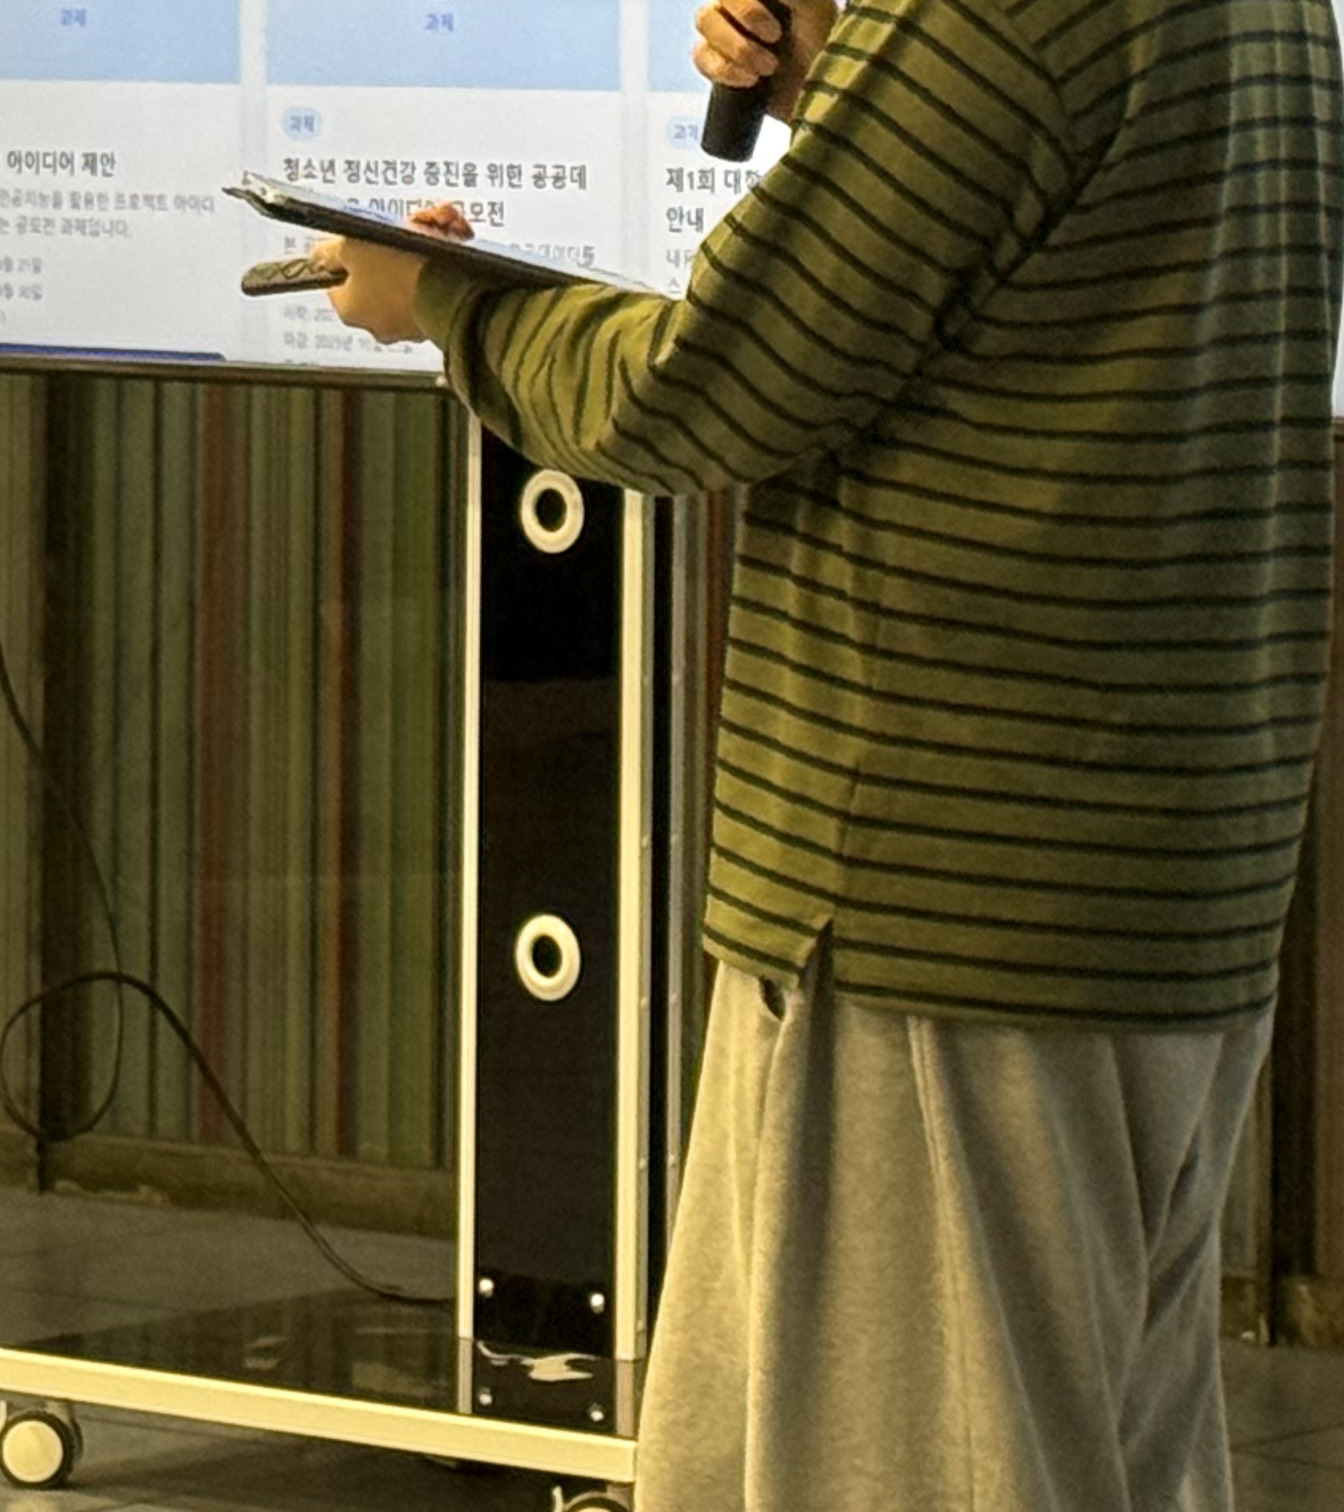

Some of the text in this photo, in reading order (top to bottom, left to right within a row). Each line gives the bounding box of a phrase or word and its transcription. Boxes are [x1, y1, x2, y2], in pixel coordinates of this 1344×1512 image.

[6, 150, 75, 177] 아이디어
[80, 151, 117, 178] 제안
[283, 157, 588, 192] 청소년 정신건강 증진을 위한 공공데
[666, 167, 716, 194] 제1회
[666, 206, 704, 233] 안내
